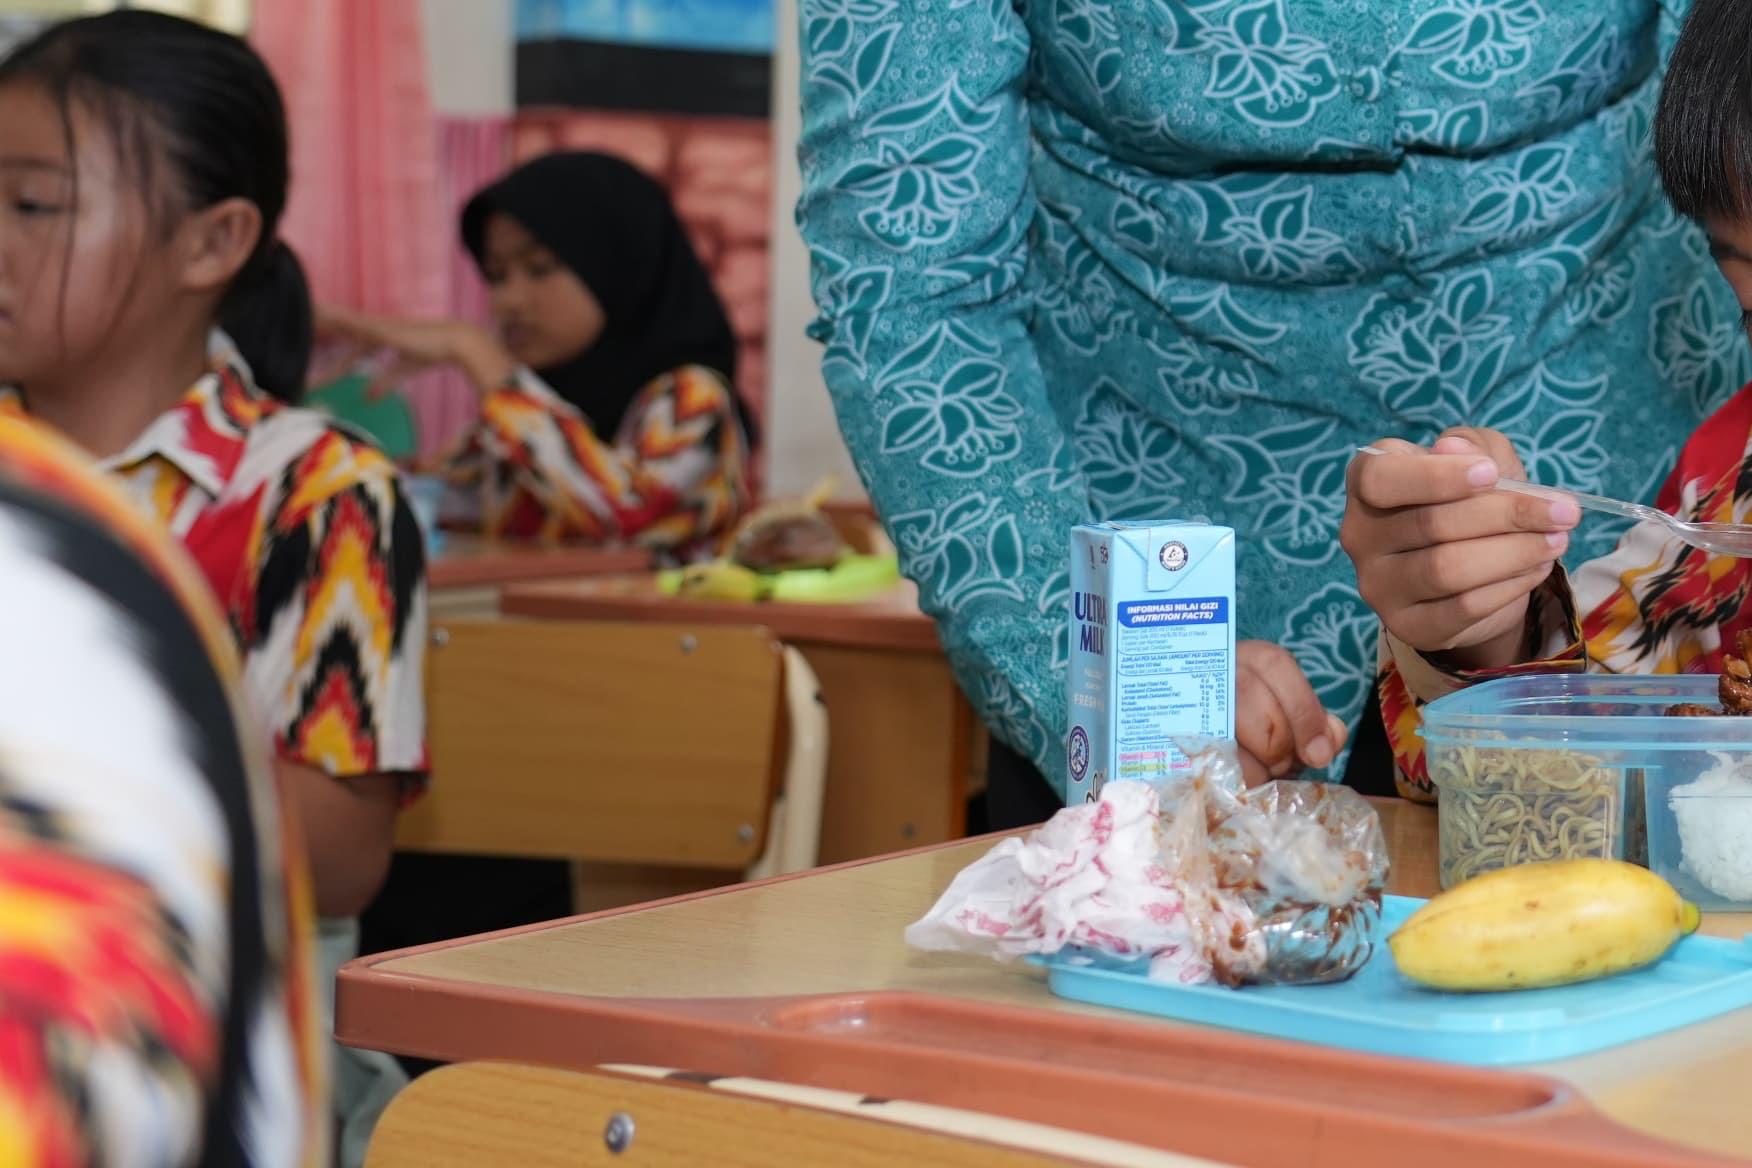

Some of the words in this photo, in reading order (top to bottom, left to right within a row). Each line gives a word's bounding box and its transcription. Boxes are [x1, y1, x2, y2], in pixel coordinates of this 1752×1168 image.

[1075, 591, 1107, 625] ULTRA
[1127, 604, 1173, 615] INFORMASI
[1175, 603, 1198, 612] NILAI
[1200, 602, 1218, 610] GIZI
[1131, 612, 1180, 623] (NUTRITION
[1182, 611, 1213, 620] FACTS)
[1080, 624, 1105, 656] MILK
